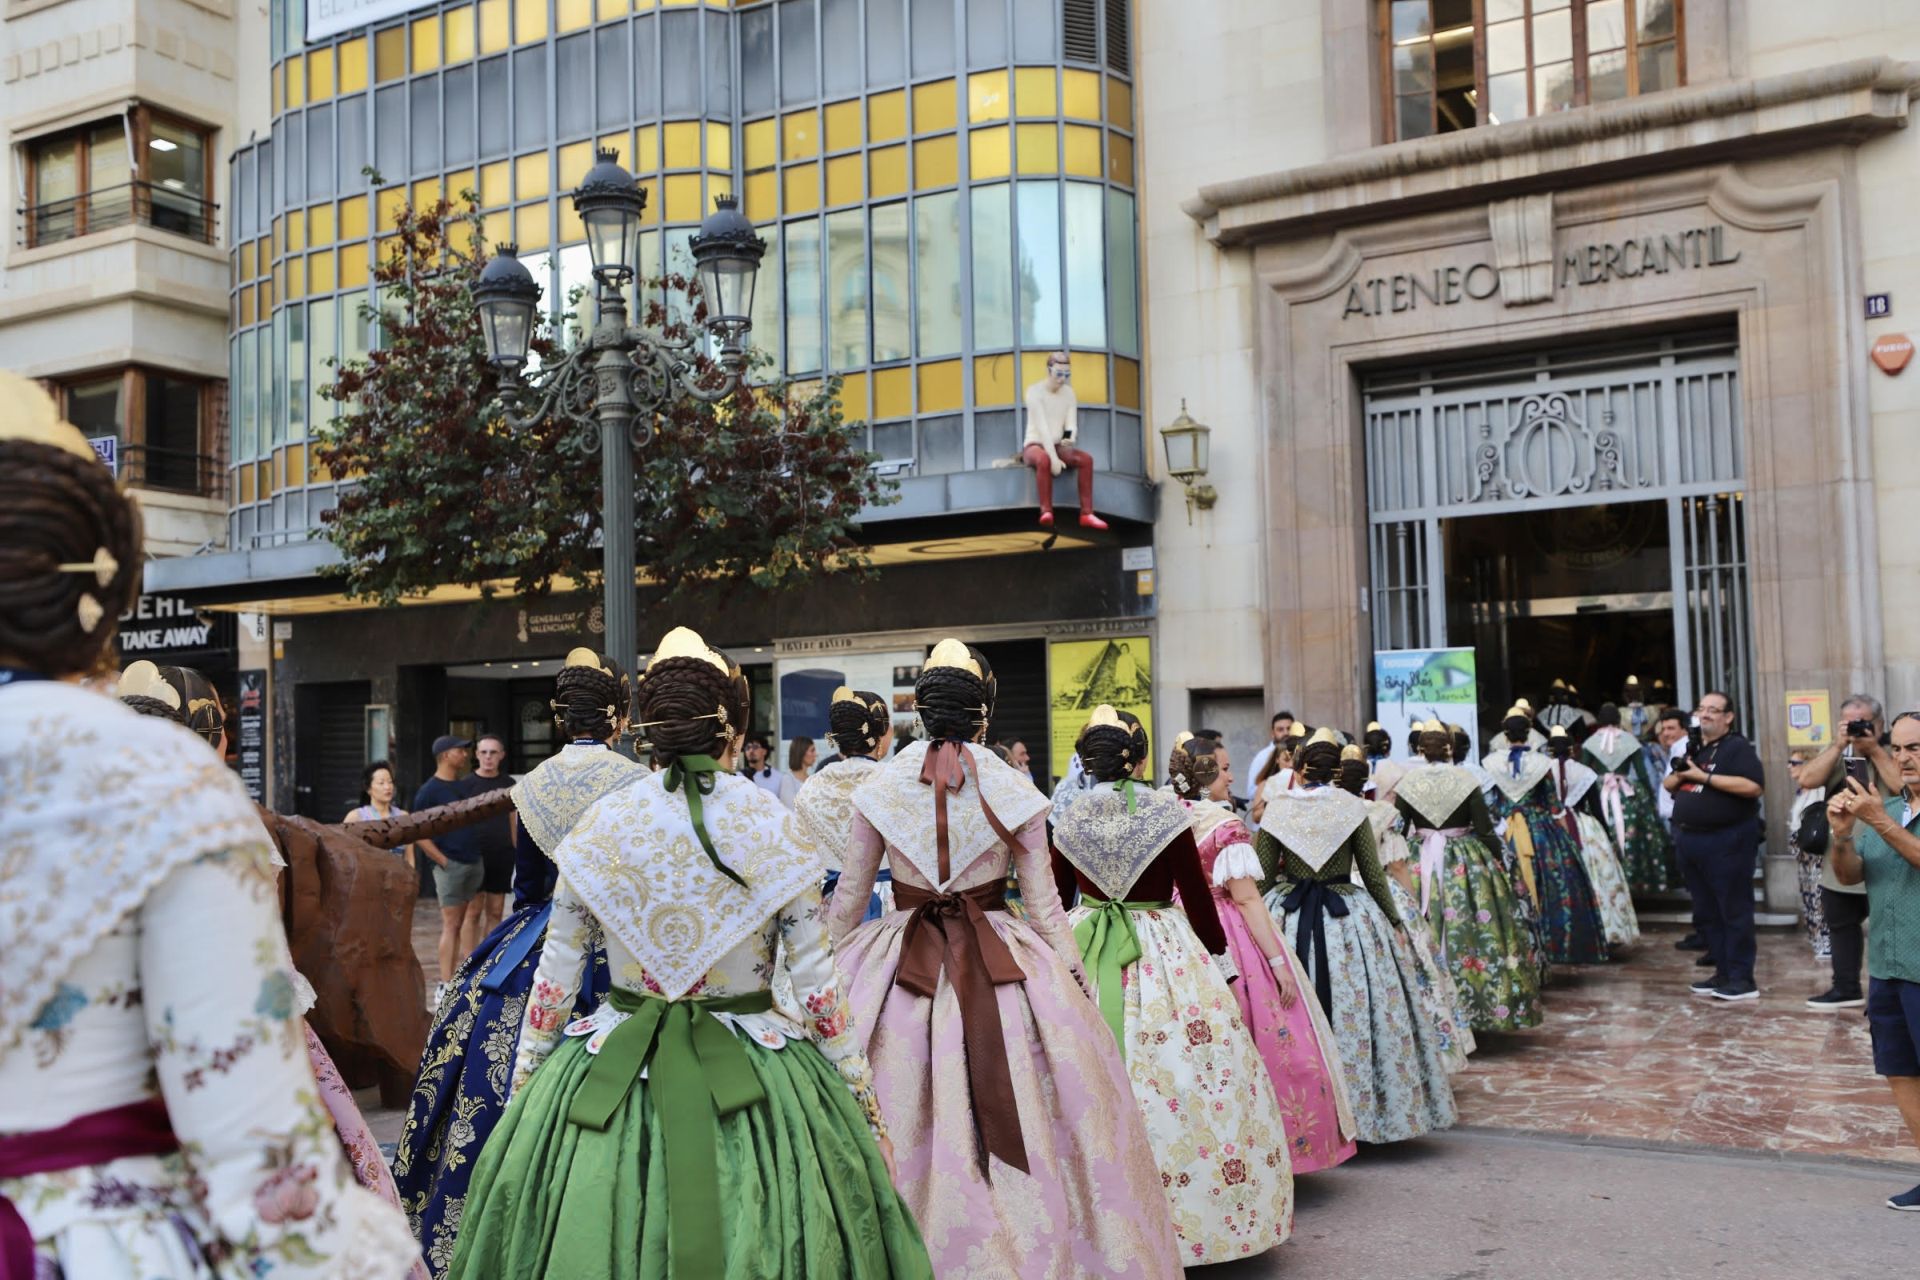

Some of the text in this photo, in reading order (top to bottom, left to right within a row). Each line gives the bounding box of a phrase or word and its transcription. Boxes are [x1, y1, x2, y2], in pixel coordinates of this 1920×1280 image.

[1342, 225, 1742, 320] ATENEO MERCANTIL
[1869, 297, 1886, 314] 18
